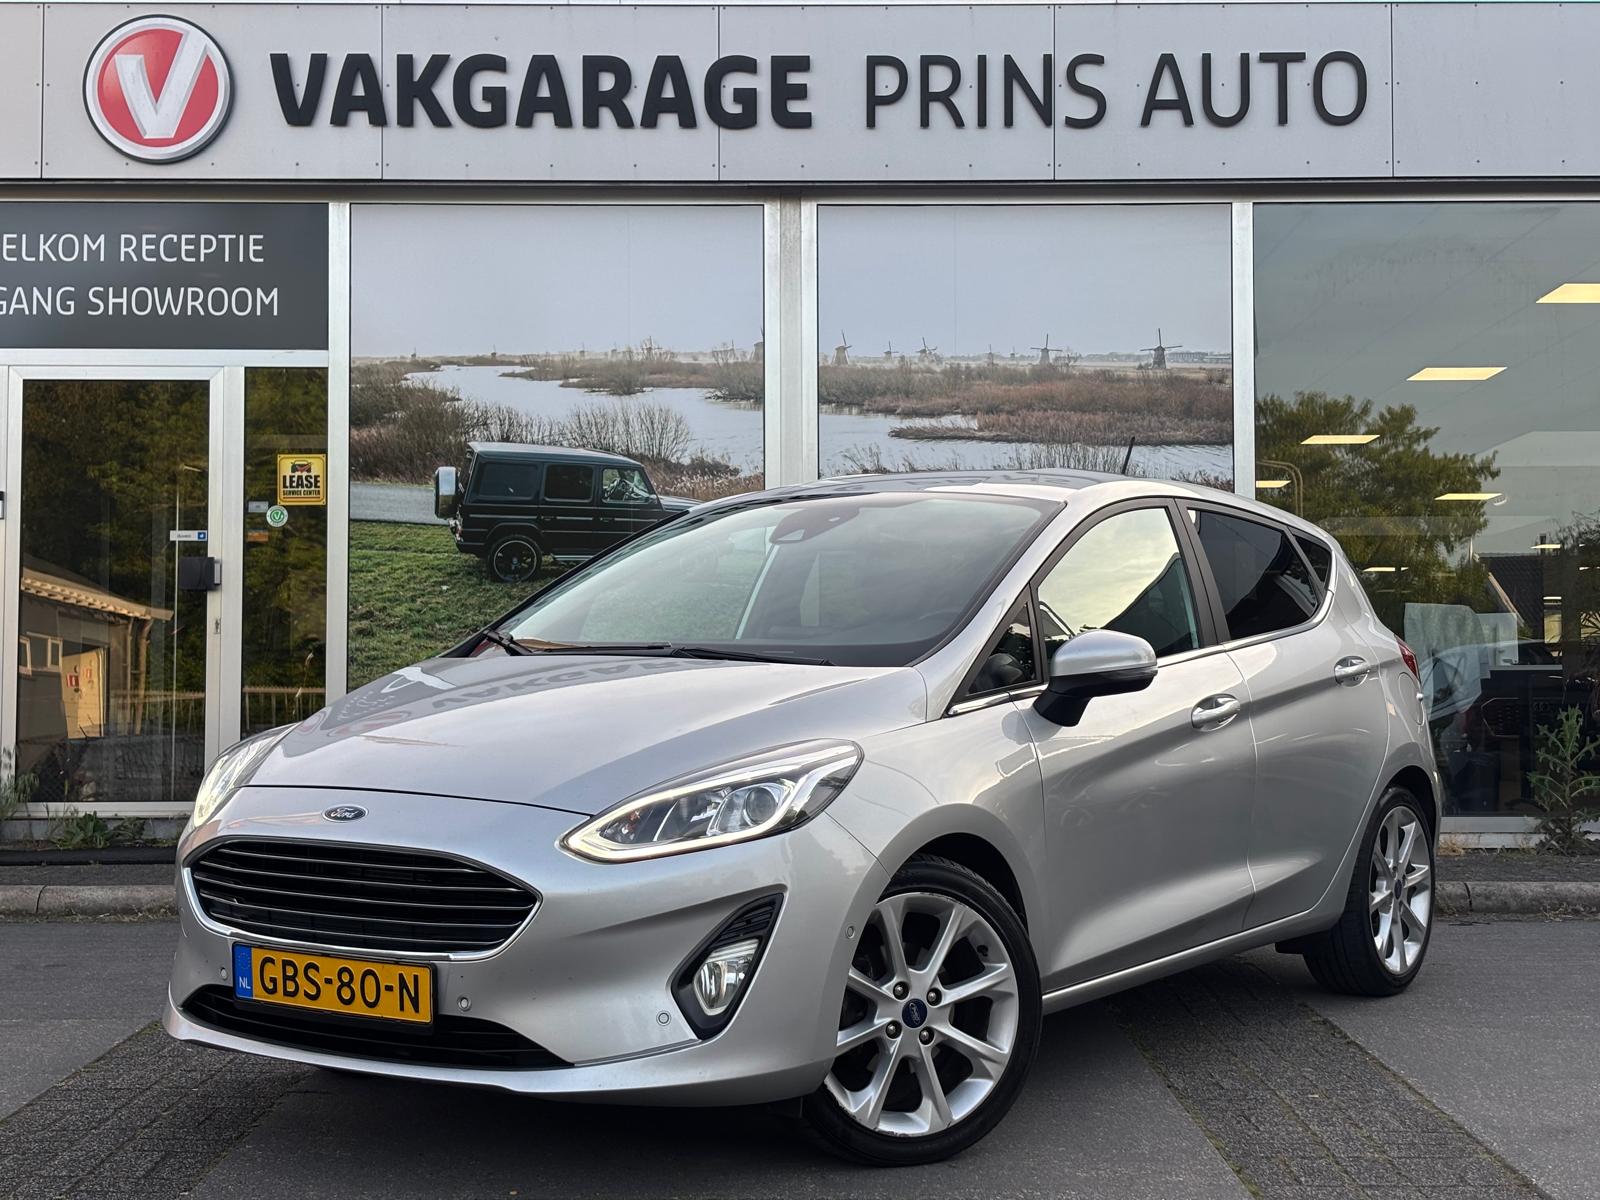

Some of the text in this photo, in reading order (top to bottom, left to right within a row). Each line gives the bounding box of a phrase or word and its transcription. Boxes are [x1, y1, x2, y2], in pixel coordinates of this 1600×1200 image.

[269, 50, 1368, 130] VAKGARAGE PRINS AUTO
[2, 233, 264, 263] ELKOM RECEPTIE
[87, 286, 278, 316] SHOWROOM
[282, 474, 321, 489] LEASE
[238, 976, 252, 990] NL
[258, 955, 421, 1014] GBS-80-N
